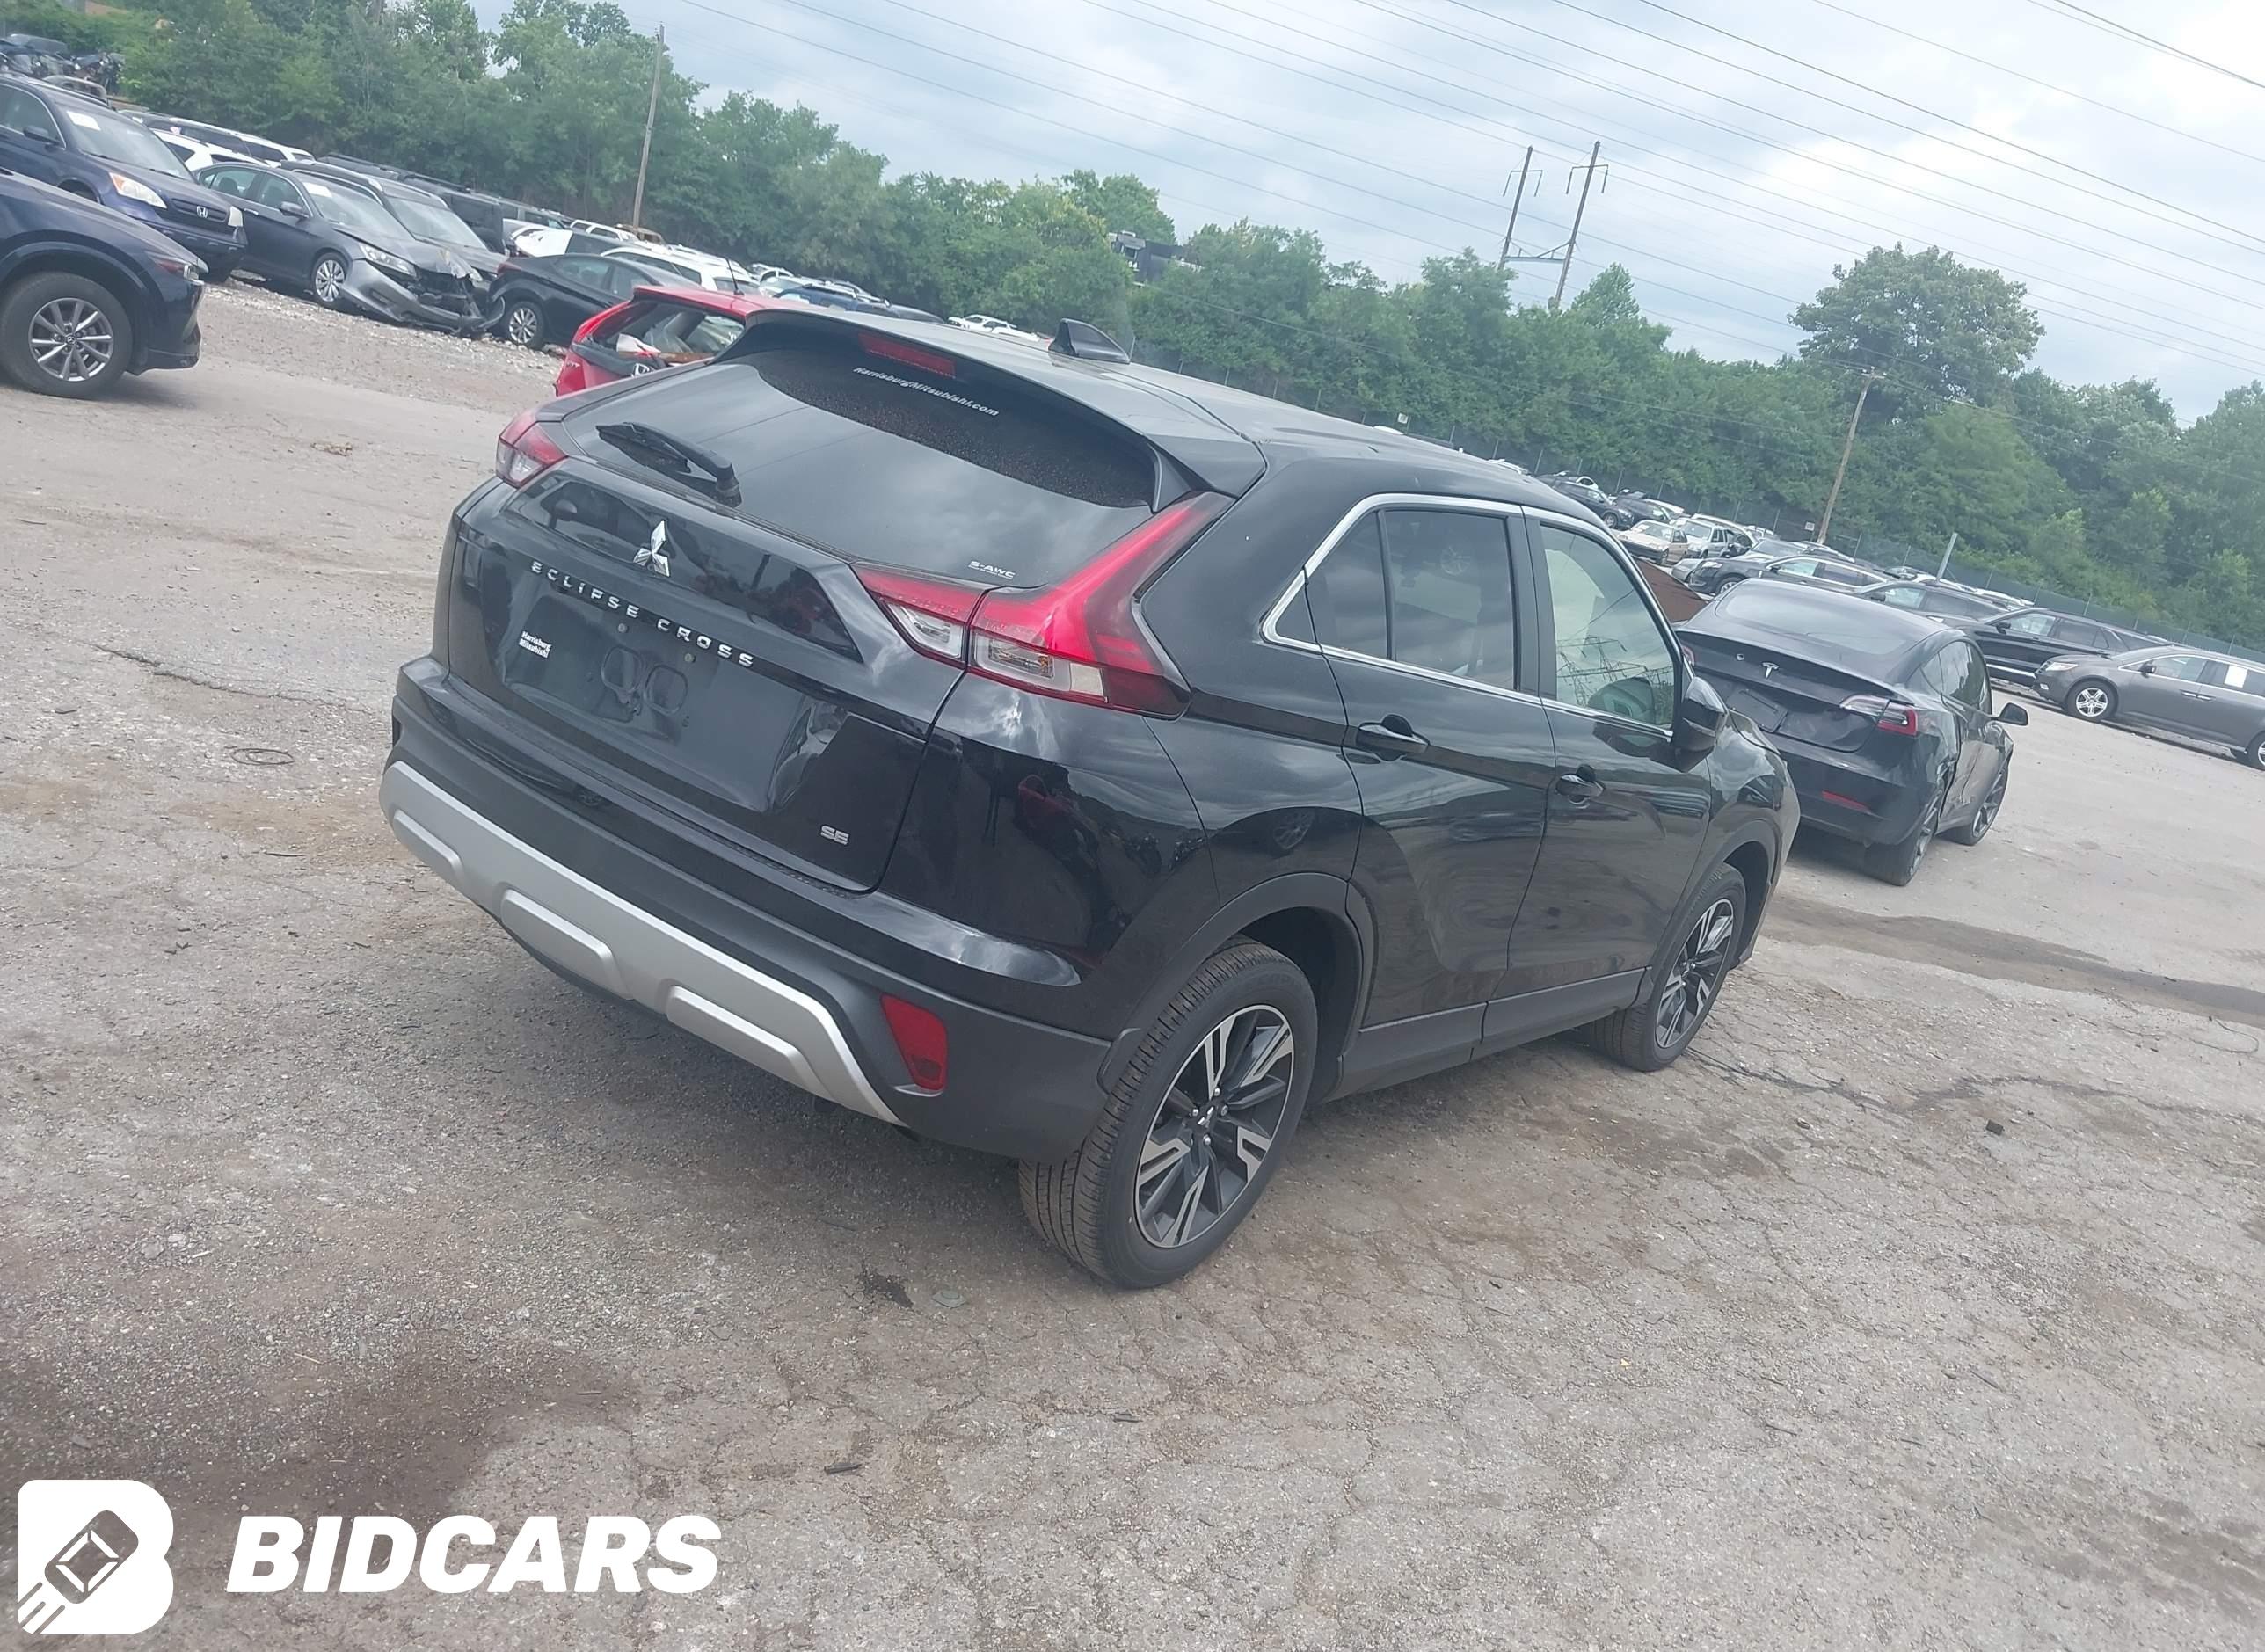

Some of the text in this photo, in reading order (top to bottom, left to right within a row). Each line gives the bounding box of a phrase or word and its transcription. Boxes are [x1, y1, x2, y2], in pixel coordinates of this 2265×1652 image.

[969, 560, 1016, 579] S-AWC
[531, 560, 754, 667] ECLIPSE CROSS
[519, 637, 549, 659] Mitsubishi
[521, 630, 552, 652] Harrisburg
[820, 825, 849, 845] SE
